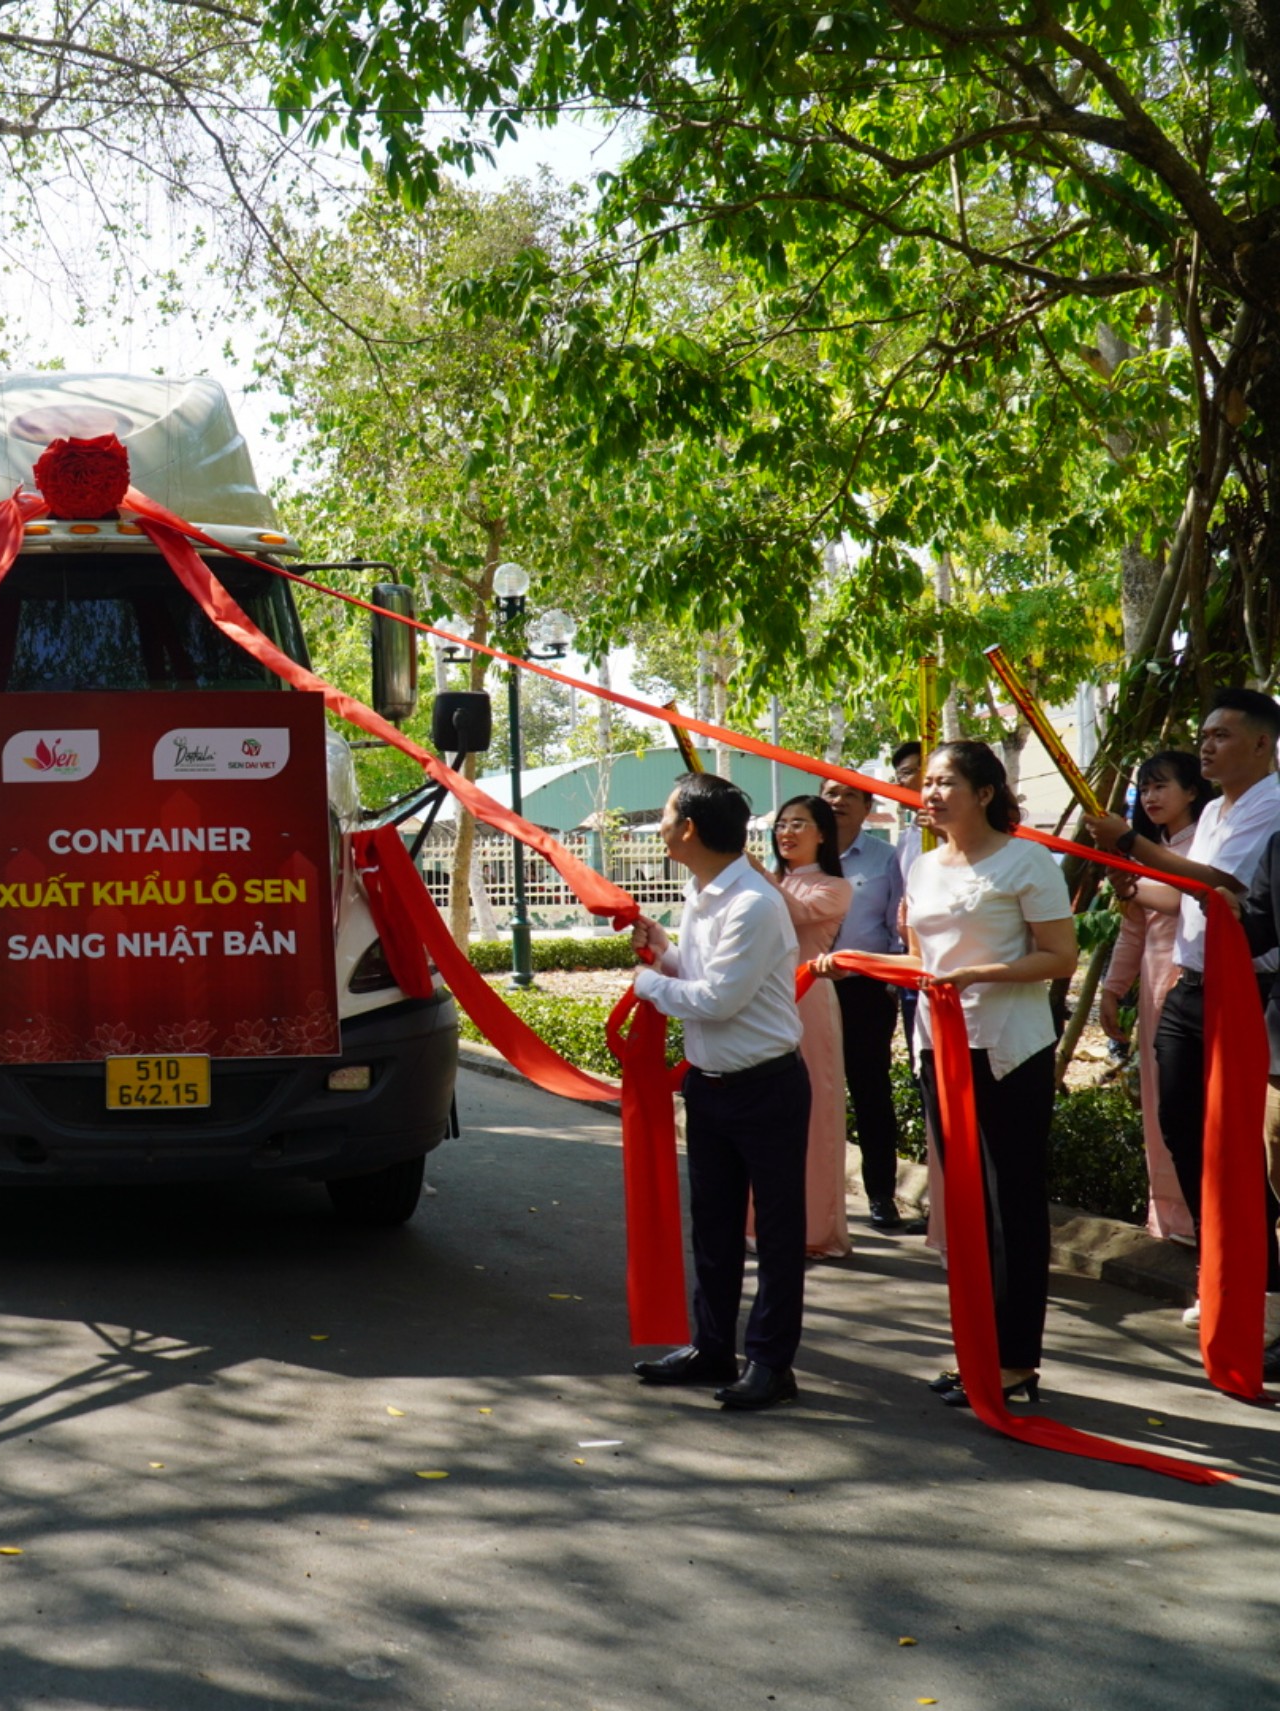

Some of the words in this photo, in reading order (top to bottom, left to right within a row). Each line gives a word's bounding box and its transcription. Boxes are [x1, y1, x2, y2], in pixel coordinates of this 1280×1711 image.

[228, 761, 244, 769] SEN
[48, 827, 251, 855] CONTAINER
[92, 870, 186, 906] KHẨU
[194, 872, 237, 905] LÔ
[244, 878, 307, 904] SEN
[8, 933, 106, 960] SANG
[118, 926, 213, 964] NHẬT
[224, 921, 296, 956] BẢN
[136, 1060, 180, 1081] 51D
[119, 1084, 199, 1106] 642.15
